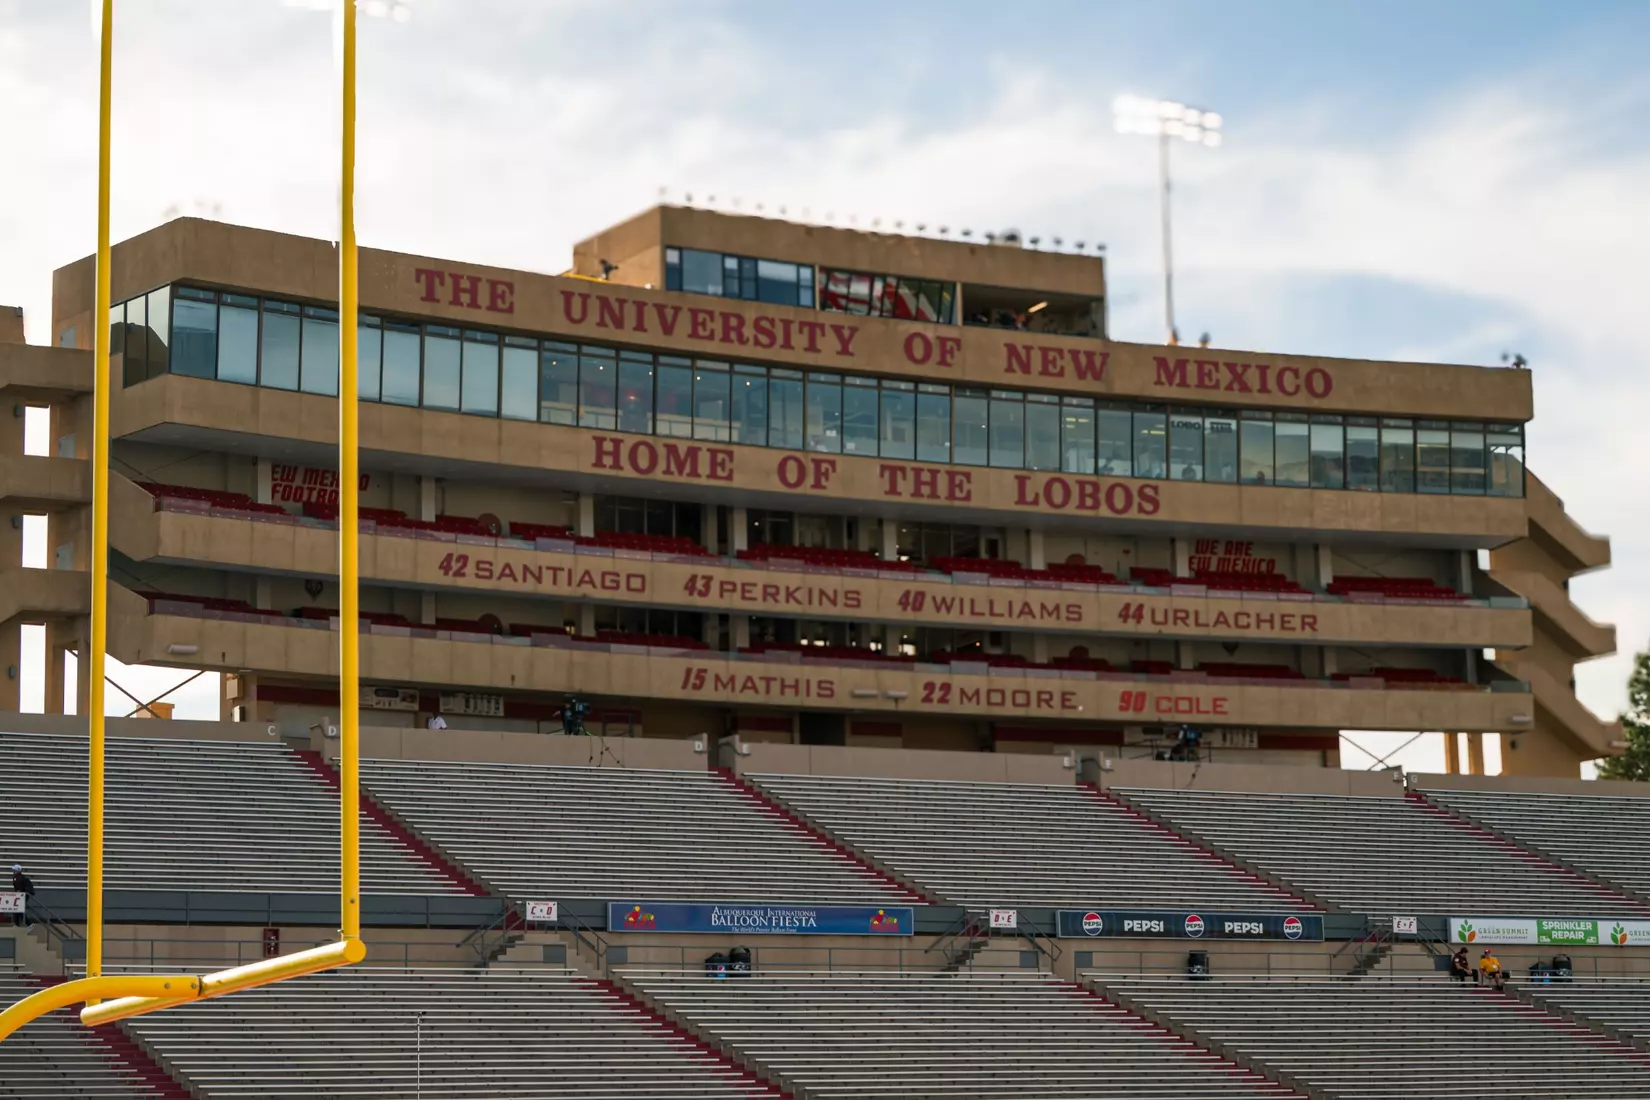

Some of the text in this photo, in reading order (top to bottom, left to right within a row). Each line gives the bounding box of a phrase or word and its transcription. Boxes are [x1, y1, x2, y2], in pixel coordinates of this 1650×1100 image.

[415, 268, 1333, 399] THE UNIVERSITY OF NEW MEXICO
[271, 463, 370, 491] EW MEXO
[591, 436, 1161, 516] HOME OF THE LOBOS
[271, 483, 340, 504] FOOTBA
[1195, 539, 1254, 556] WE ARE
[438, 553, 646, 594] 42 SANTIAGO
[1188, 556, 1276, 574] EW MEXICO
[683, 573, 862, 609] 43 PERKINS
[898, 589, 1083, 622] 40 WILLIAMS
[1118, 602, 1319, 632] 44 URLACHER
[681, 667, 836, 699] 15 MATHIS
[921, 681, 1078, 710] 22 MOORE
[1118, 690, 1229, 716] 90 COLE
[267, 725, 276, 736] C
[328, 725, 337, 736] D
[694, 740, 703, 751] D
[531, 906, 553, 915] C D
[713, 906, 816, 917] ALBUQUERQUE INTERNATIONAL
[994, 914, 1000, 923] D
[711, 914, 817, 927] BALLOON FIESTA
[1124, 919, 1164, 932] PEPSI
[1224, 921, 1263, 934] PEPSI
[1542, 921, 1592, 930] SPRINKLER
[1551, 930, 1585, 940] REPAIR
